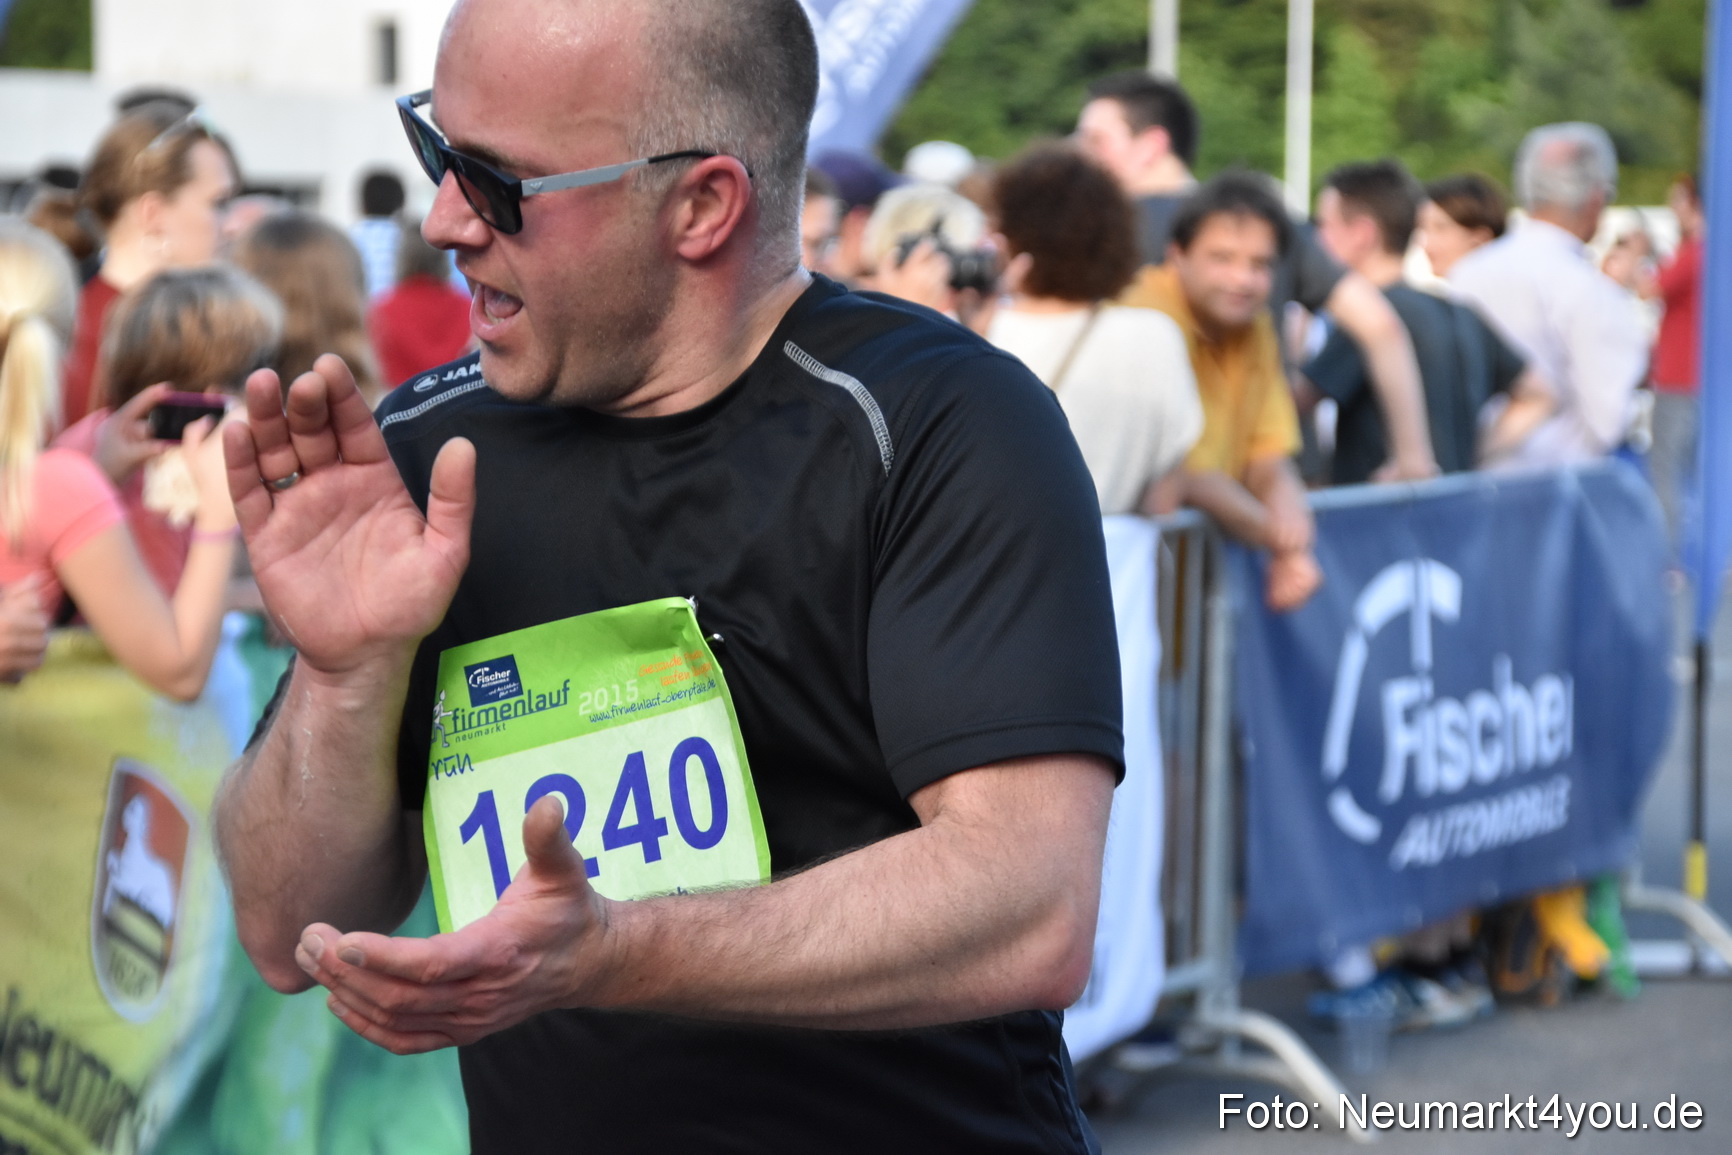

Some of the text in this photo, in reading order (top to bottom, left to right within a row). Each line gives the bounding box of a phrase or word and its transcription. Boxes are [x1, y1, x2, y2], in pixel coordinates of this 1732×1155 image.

[442, 361, 483, 382] JAK
[477, 669, 511, 685] Fischer
[452, 679, 639, 734] firmenlauf 2015
[455, 722, 507, 743] neumarkt
[1388, 772, 1572, 873] AUTOMOBILE
